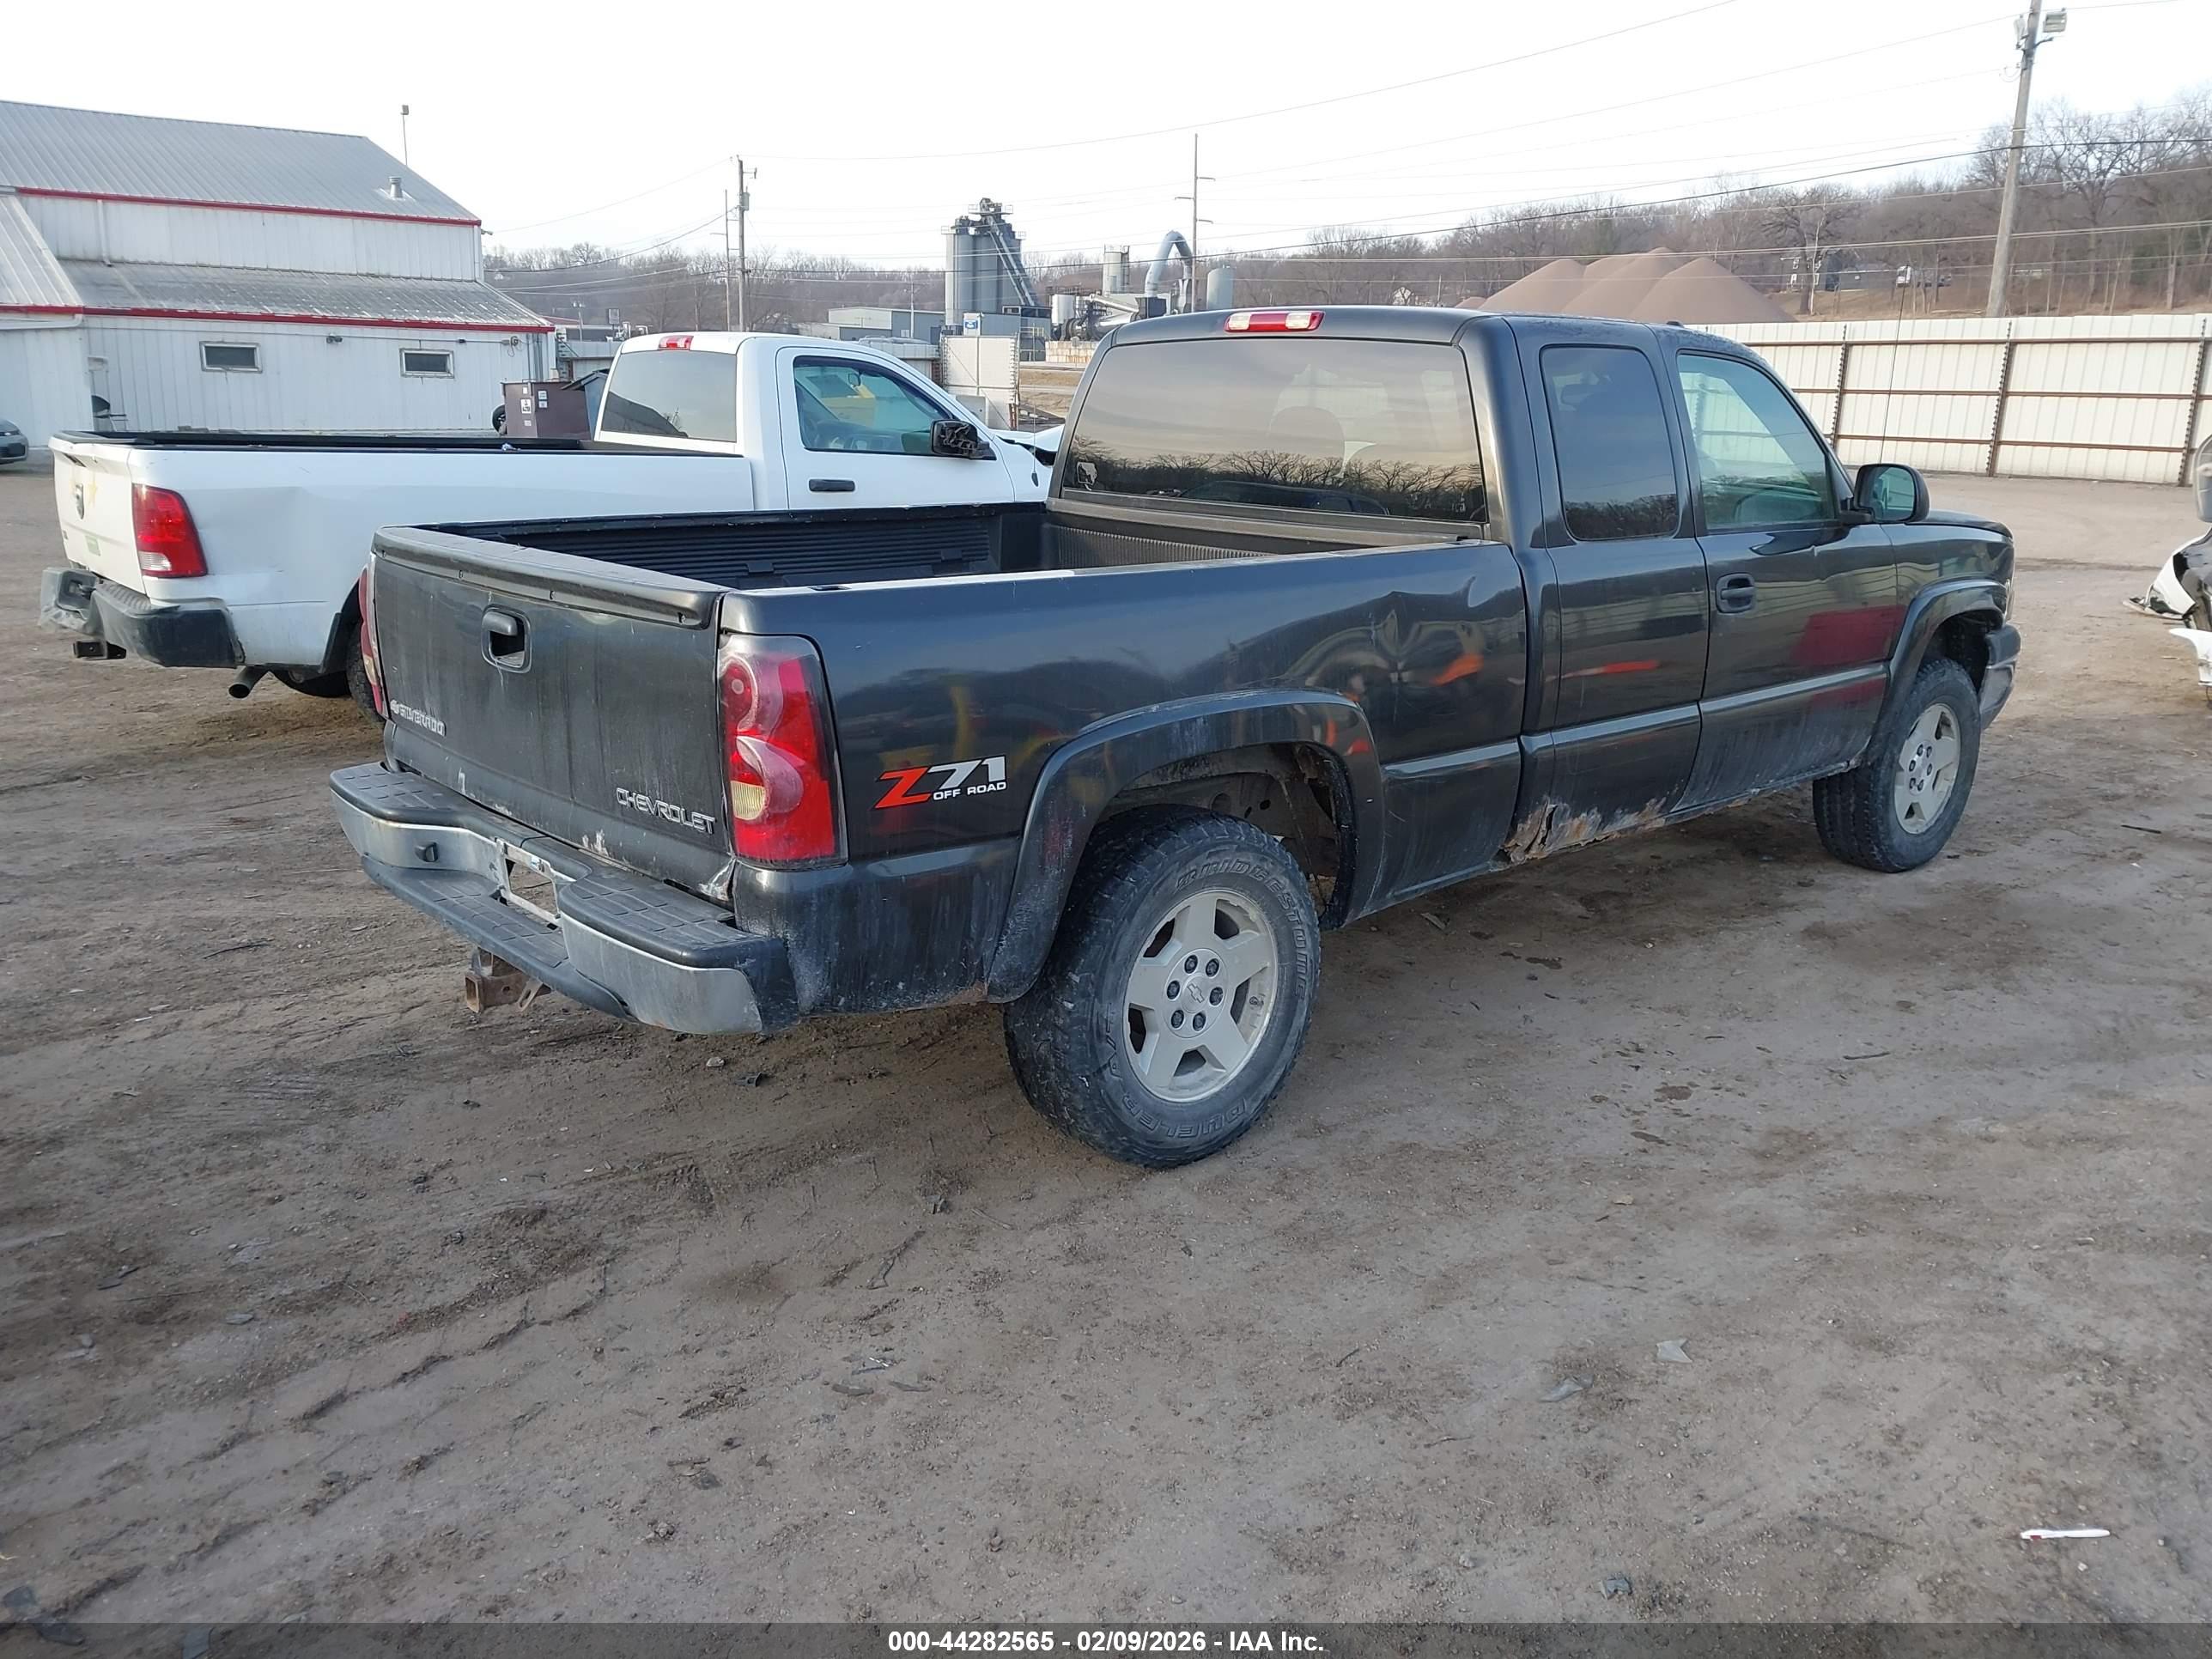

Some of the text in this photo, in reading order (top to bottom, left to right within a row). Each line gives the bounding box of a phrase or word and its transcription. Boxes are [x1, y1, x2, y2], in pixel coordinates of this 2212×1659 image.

[874, 756, 1006, 809] Z71
[933, 781, 1006, 800] OFF ROAD
[616, 787, 716, 835] CHEVROLET
